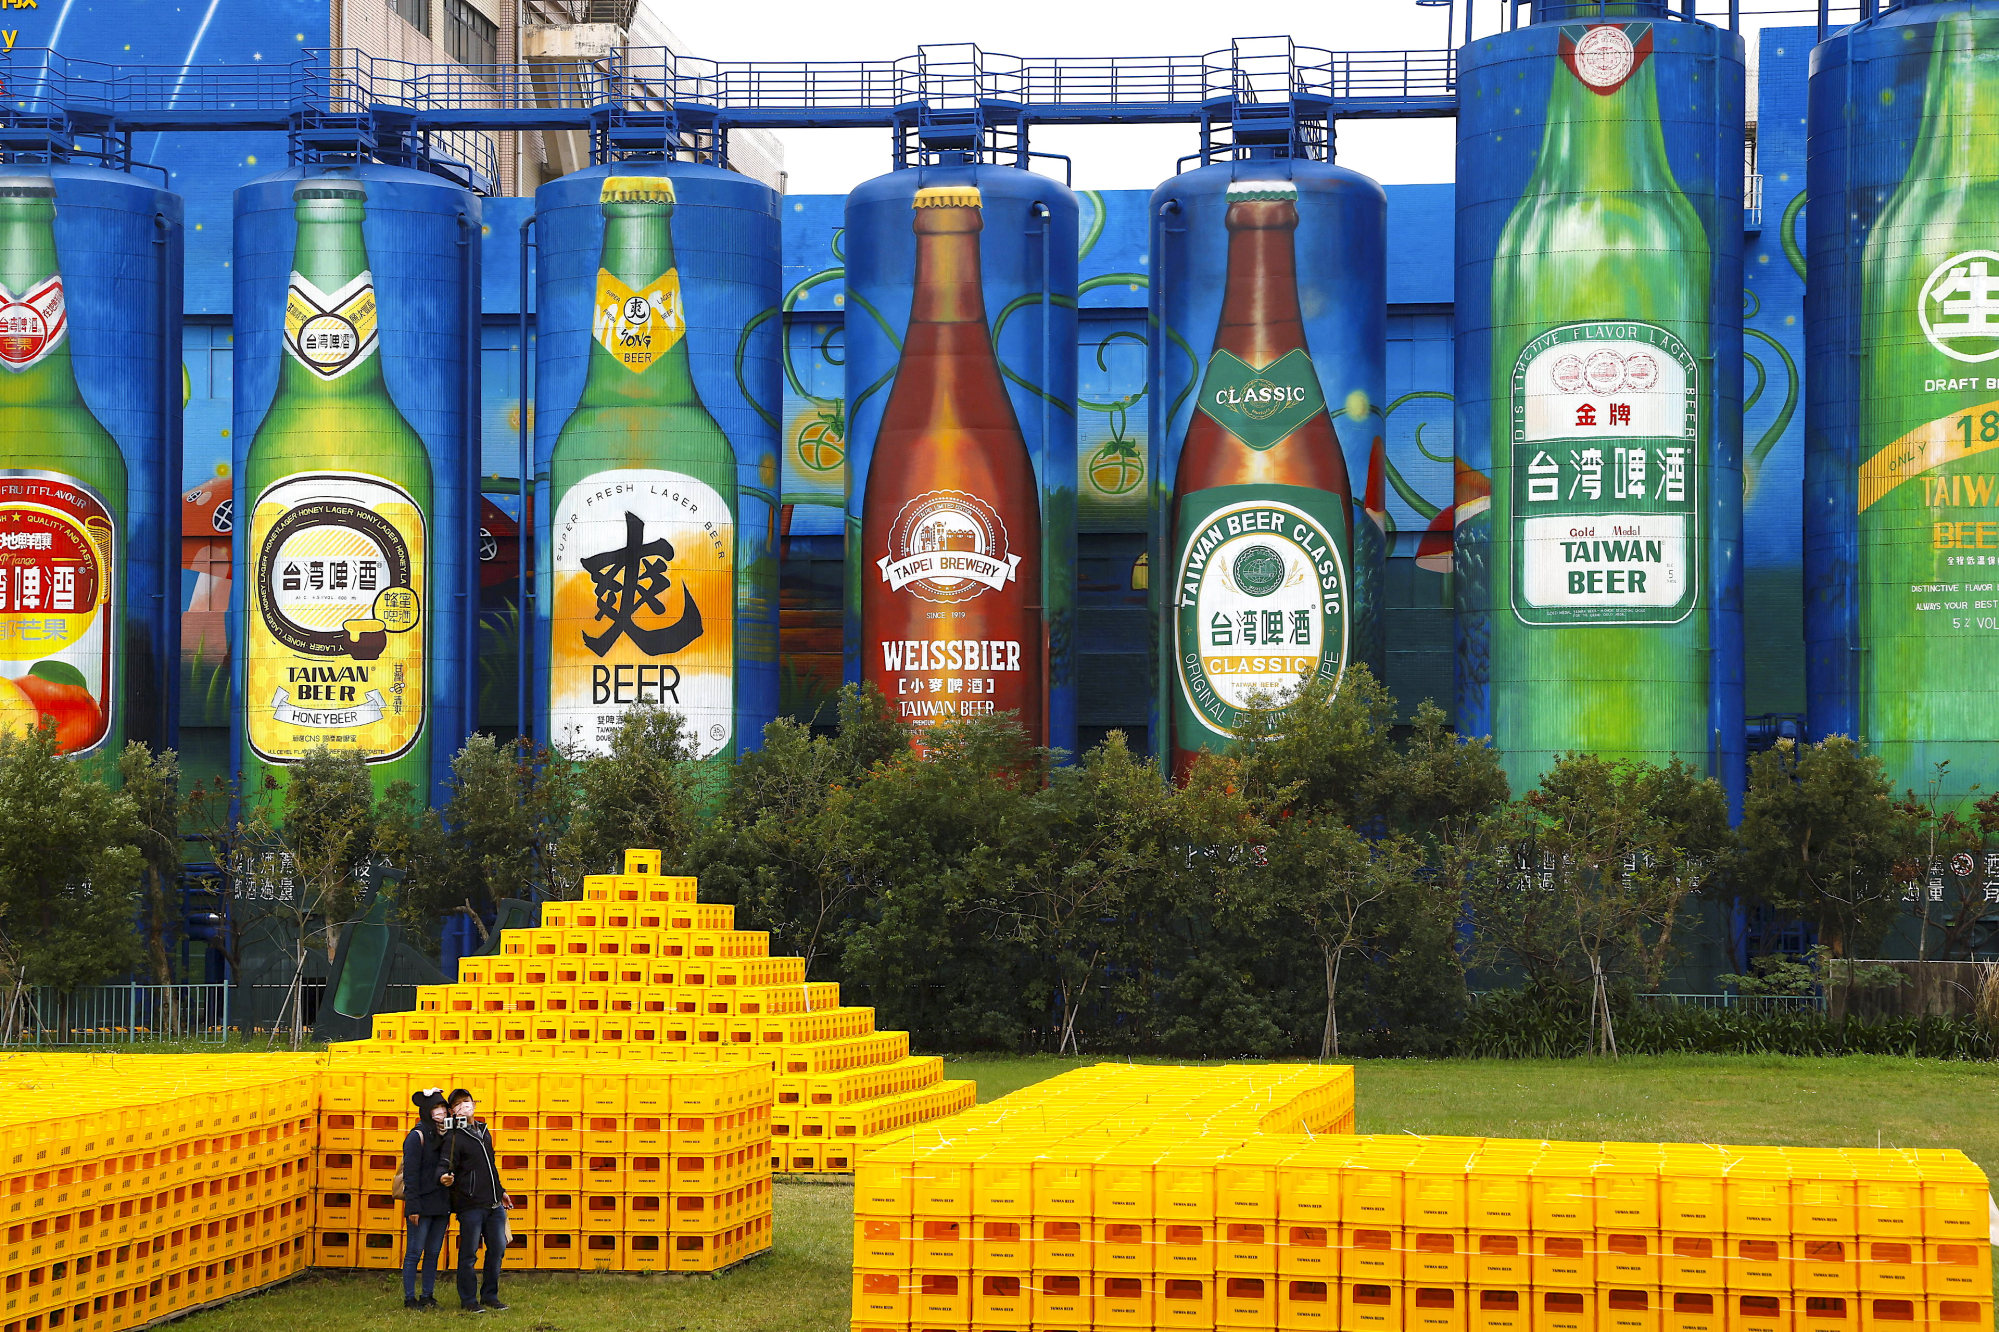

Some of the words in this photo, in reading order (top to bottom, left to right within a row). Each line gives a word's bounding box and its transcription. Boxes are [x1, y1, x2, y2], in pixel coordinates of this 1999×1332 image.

[605, 289, 621, 303] SUPER
[656, 291, 673, 305] LAGER
[627, 298, 646, 319] 爽
[3, 337, 33, 350] 芒果
[624, 352, 652, 363] BEER
[1514, 332, 1560, 440] DISTINCTIVE
[1573, 326, 1638, 340] FLAVOR
[1650, 330, 1695, 374] LAGER
[1685, 387, 1696, 437] BEER
[1925, 378, 1979, 391] DRAFT
[1216, 387, 1306, 405] CLASSIC
[1575, 403, 1631, 426] 金牌
[1888, 442, 1927, 471] ONLY
[1920, 475, 1999, 506] TAIW
[298, 506, 324, 517] HONEY
[326, 506, 354, 515] LAGER
[376, 520, 398, 544] LAGER
[556, 513, 579, 561] SUPER
[586, 484, 634, 507] FRESH
[650, 485, 698, 515] LAGER
[704, 521, 726, 559] BEER
[1569, 527, 1595, 537] Gold
[1612, 525, 1641, 536] Medal
[27, 515, 65, 531] QUALITY
[64, 529, 80, 544] AND
[78, 542, 94, 571] TASTY
[1560, 540, 1662, 563] TAIWAN
[0, 553, 36, 566] Mango
[894, 558, 933, 580] TAIPEI
[940, 557, 1000, 578] BREWERY
[1181, 524, 1225, 609] TAIWAN
[1226, 511, 1285, 536] BEER
[1293, 524, 1340, 615] CLASSIC
[580, 510, 705, 658] 爽
[1568, 570, 1647, 594] BEER
[1912, 585, 1959, 593] DISTINCTIVE
[1965, 584, 1993, 592] FLAVOR
[1915, 603, 1941, 611] ALWAYS
[1944, 602, 1968, 610] YOUR
[1975, 600, 1999, 609] BEST
[266, 613, 283, 634] LAGER
[282, 634, 307, 648] HONEY
[309, 644, 336, 652] LAGER
[882, 640, 1021, 671] WEISSBIER
[1209, 657, 1308, 673] CLASSIC
[286, 666, 369, 683] TAIWAN
[592, 664, 680, 704] BEER
[298, 684, 356, 701] BEER
[1185, 653, 1228, 723] ORIGINAL
[899, 700, 956, 717] TAIWAN
[960, 700, 995, 716] BEER
